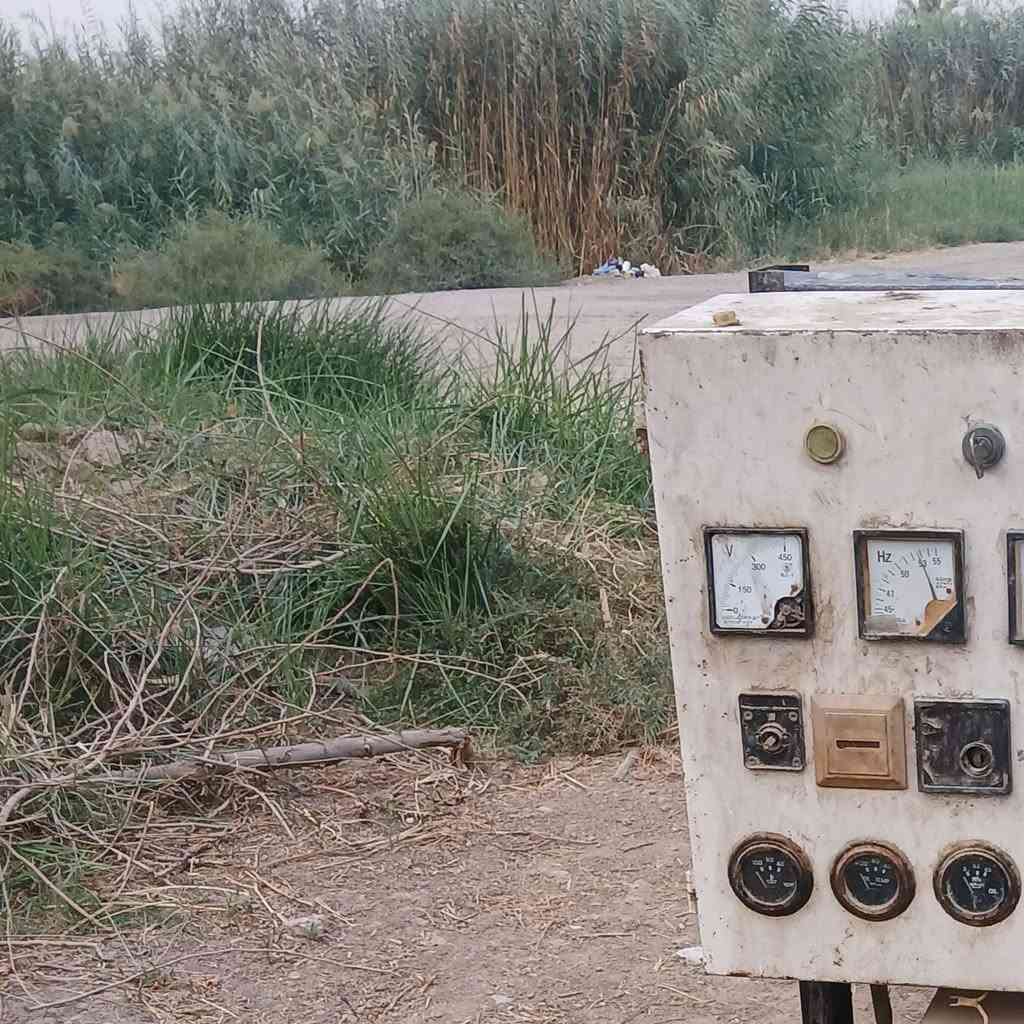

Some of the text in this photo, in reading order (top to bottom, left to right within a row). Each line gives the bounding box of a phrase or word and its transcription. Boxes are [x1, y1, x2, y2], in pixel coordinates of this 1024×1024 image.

[778, 553, 792, 561] 450
[876, 550, 892, 562] Hz
[932, 557, 942, 565] 55
[752, 563, 766, 571] 300
[738, 586, 752, 594] 150
